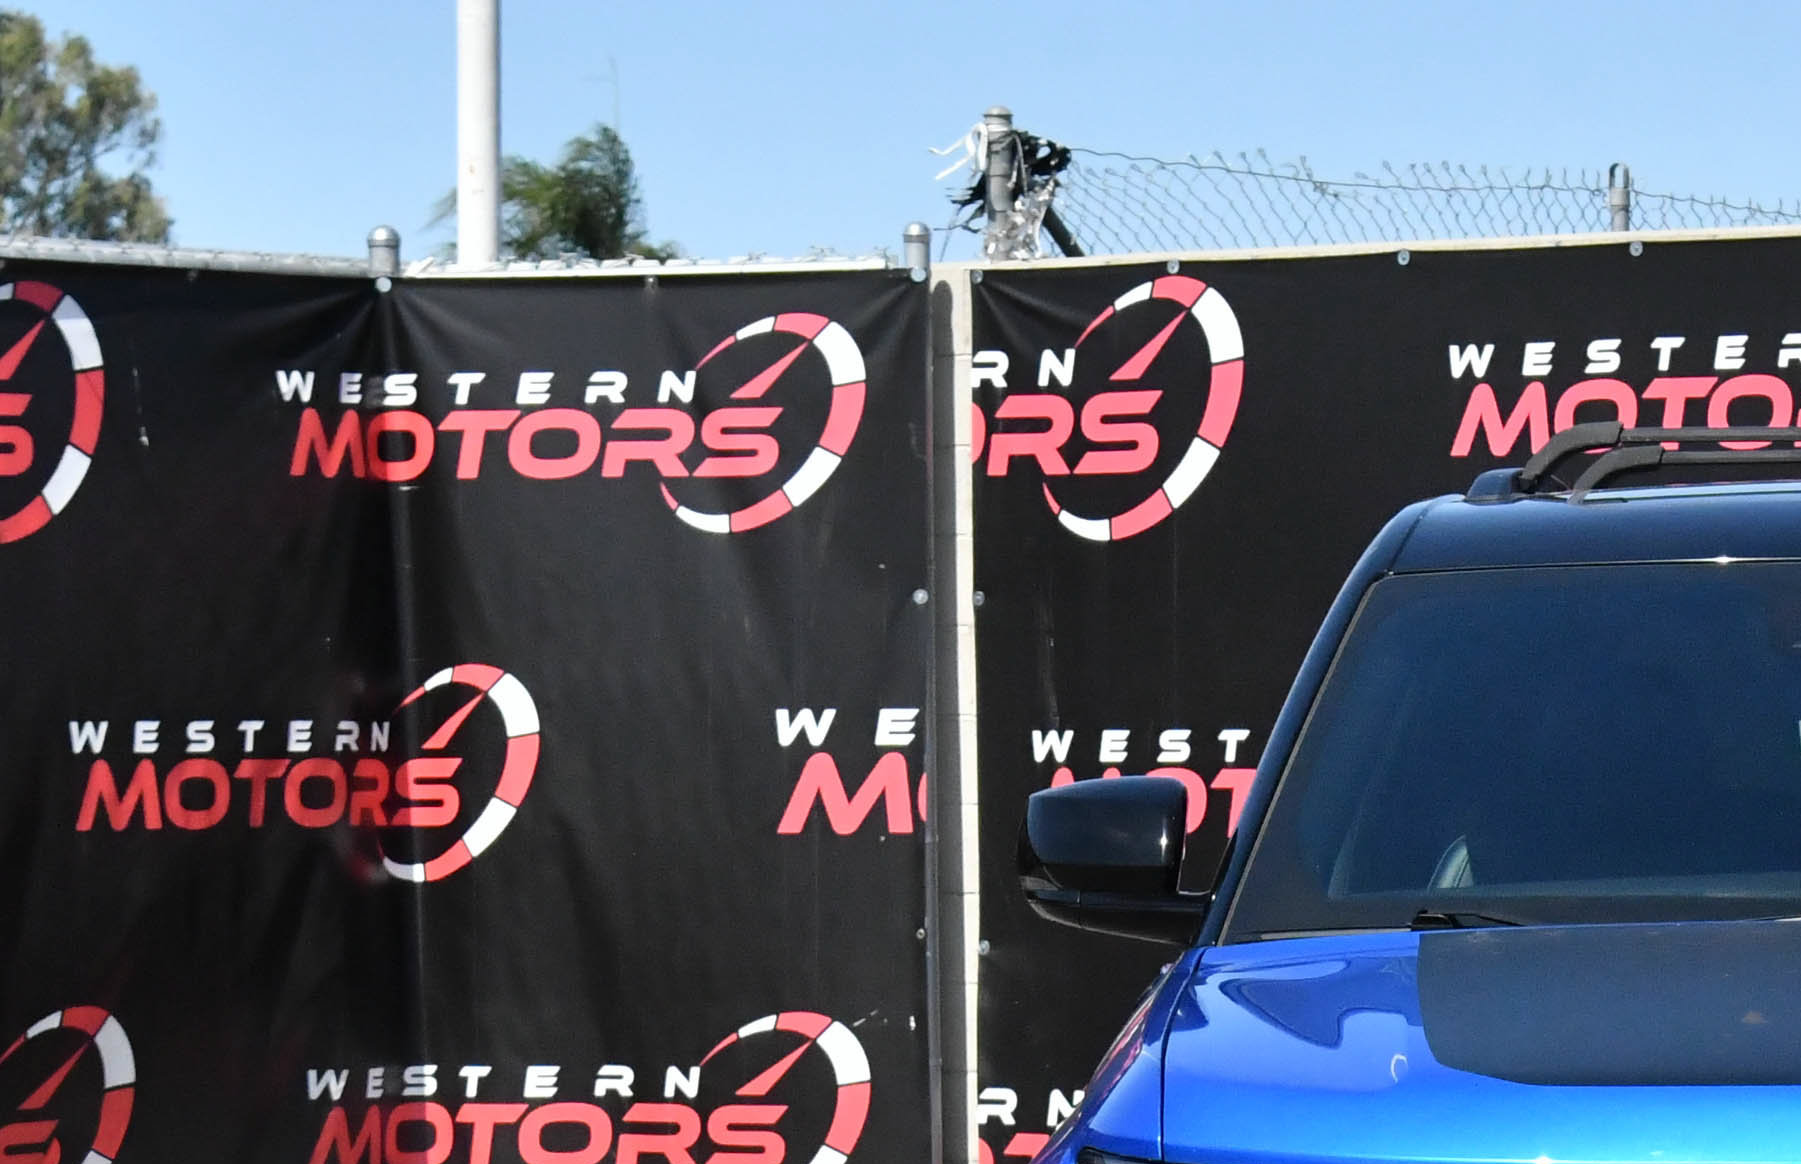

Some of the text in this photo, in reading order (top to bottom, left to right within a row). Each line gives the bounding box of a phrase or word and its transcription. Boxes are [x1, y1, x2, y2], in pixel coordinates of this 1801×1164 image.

[277, 370, 696, 405] WESTERN
[290, 407, 785, 482] MOTORS
[972, 390, 1163, 477] RS
[70, 721, 390, 754] WESTERN
[1032, 729, 1250, 763] WEST
[77, 757, 463, 832] MOTORS
[777, 752, 927, 836] M
[309, 1065, 700, 1100] WESTERN
